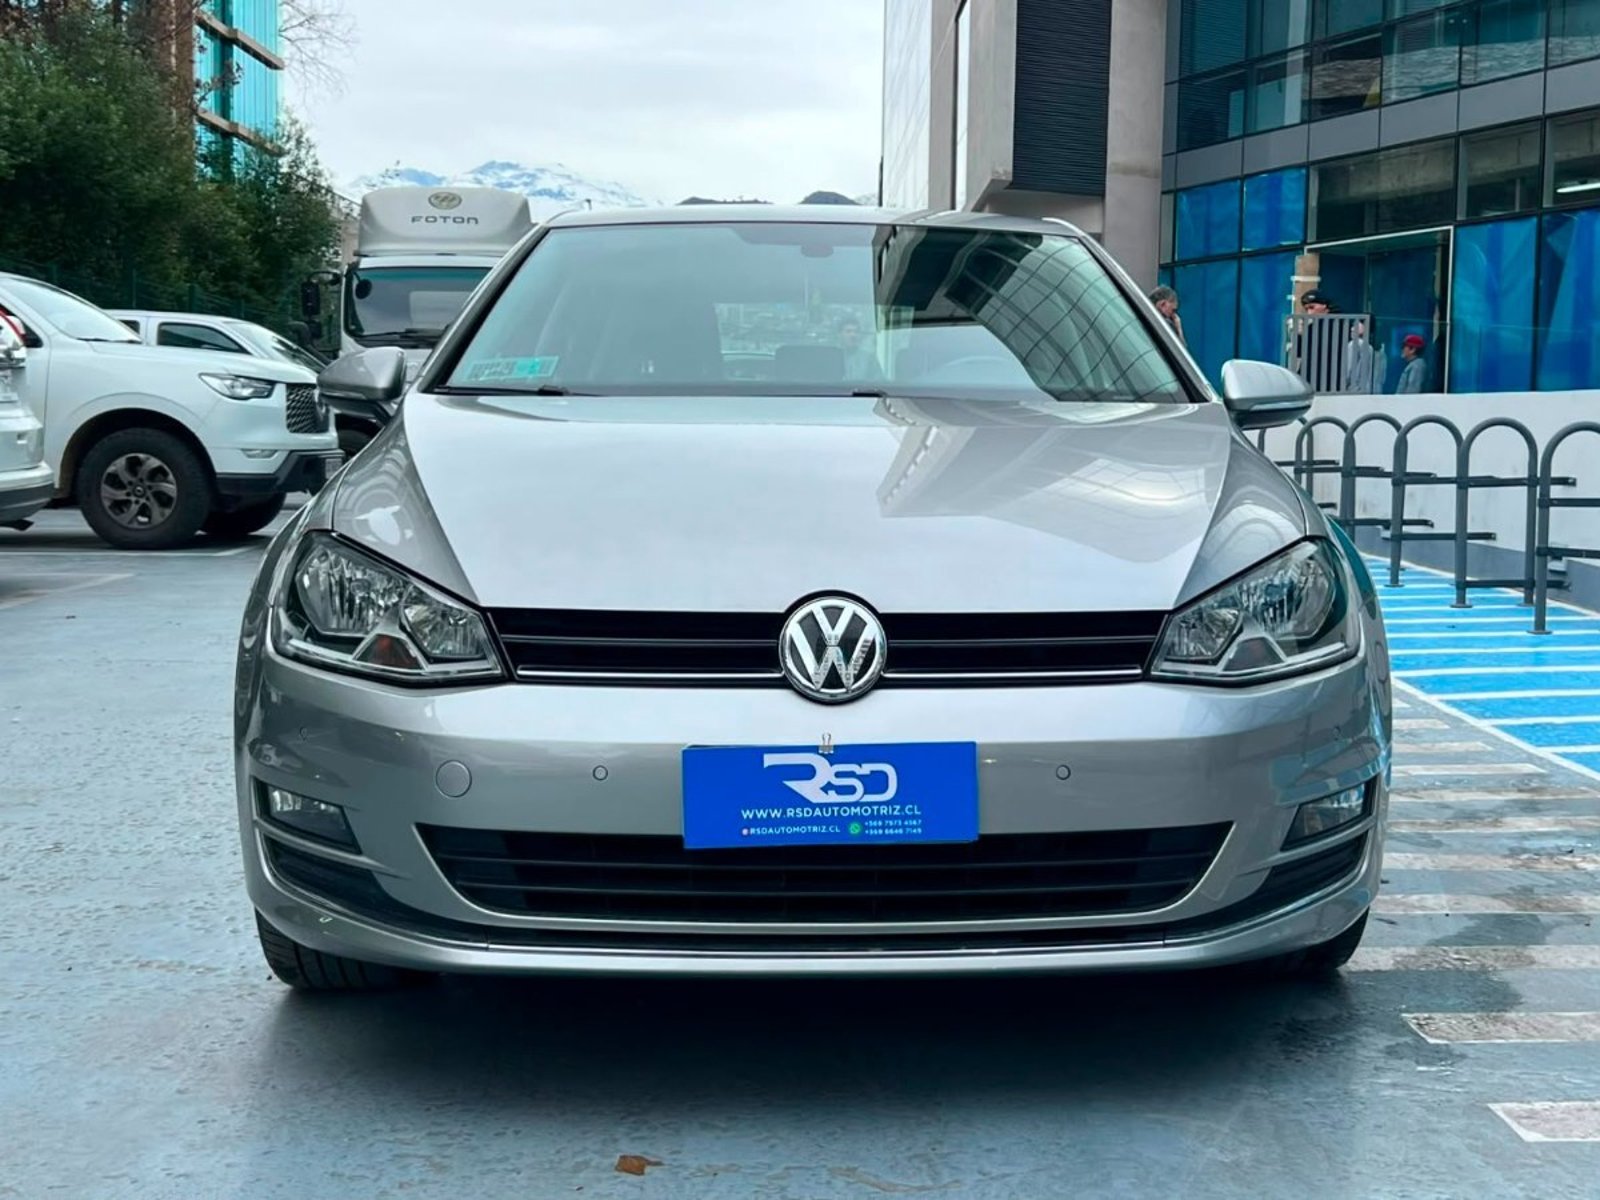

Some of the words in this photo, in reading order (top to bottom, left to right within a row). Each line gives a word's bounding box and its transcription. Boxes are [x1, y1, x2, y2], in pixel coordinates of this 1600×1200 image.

[411, 215, 479, 225] FOTON
[785, 600, 878, 692] VW
[763, 752, 897, 804] RSD
[741, 804, 922, 819] WWW.RSDAUTOMOTRIZ.CL
[750, 825, 841, 835] RSDAUTOMOTRIZ.CL
